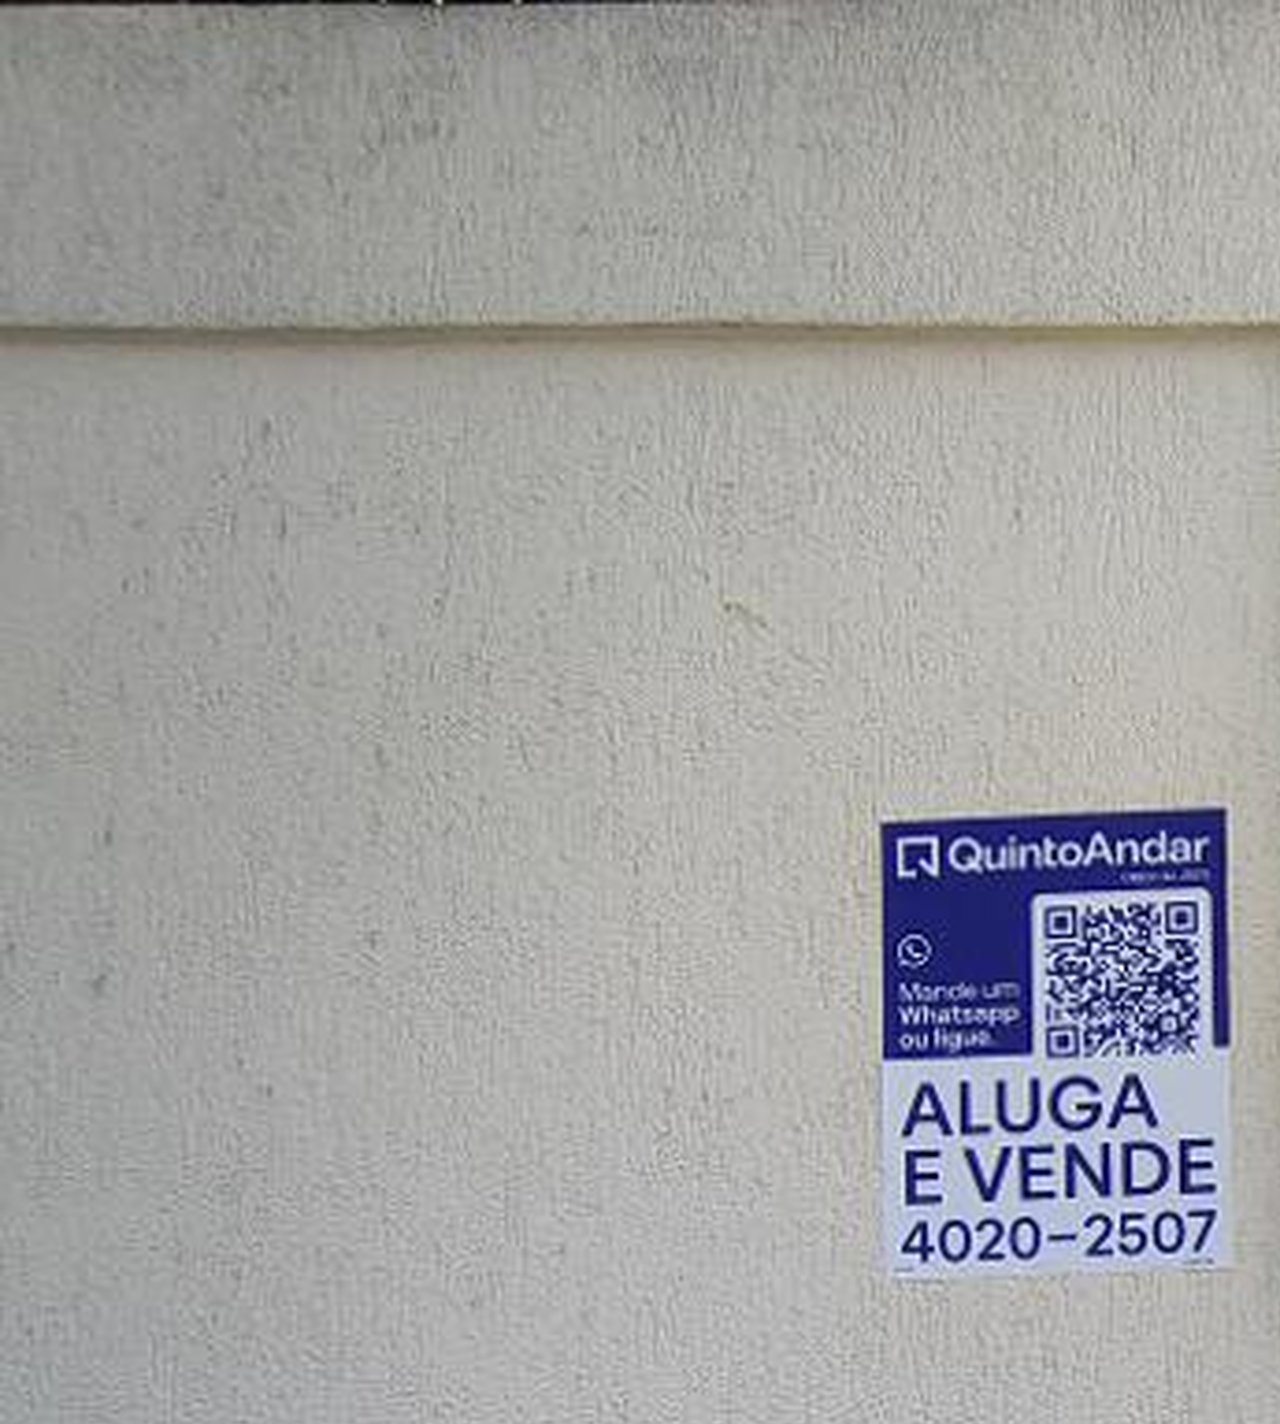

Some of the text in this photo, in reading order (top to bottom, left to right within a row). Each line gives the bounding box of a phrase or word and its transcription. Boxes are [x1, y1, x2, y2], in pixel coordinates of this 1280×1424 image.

[948, 830, 1211, 874] QuintoAndar
[899, 982, 1020, 1001] Mande um
[899, 1032, 929, 1052] ou
[901, 1073, 1159, 1137] ALUGA
[904, 1138, 1217, 1206] E VENDE
[900, 1209, 1218, 1264] 4020-2507
